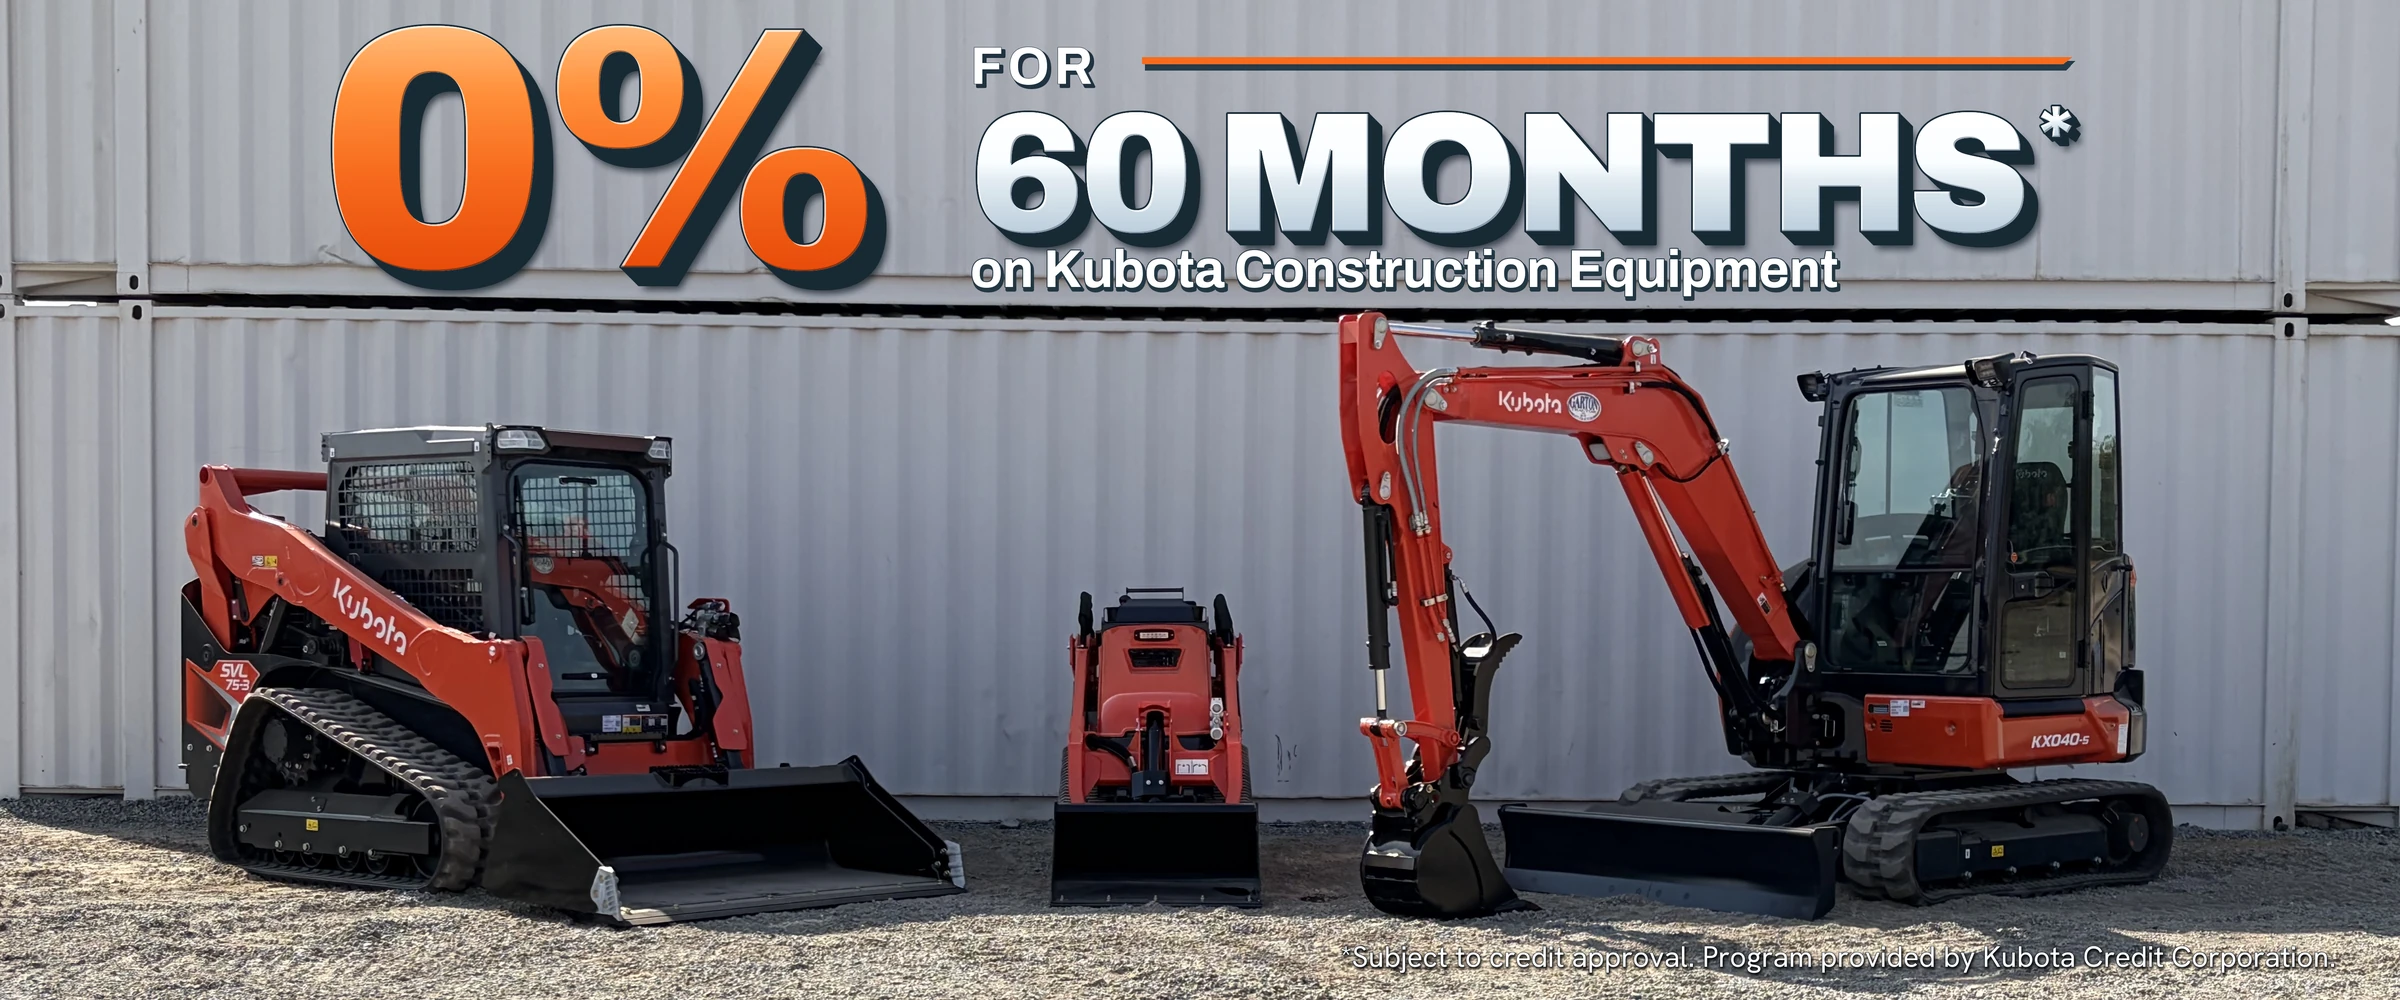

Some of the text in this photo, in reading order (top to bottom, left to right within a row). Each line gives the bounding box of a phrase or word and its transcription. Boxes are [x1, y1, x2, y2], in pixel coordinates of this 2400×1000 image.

[1498, 390, 1562, 414] Kubota
[332, 577, 407, 656] Kubota
[220, 663, 248, 678] SVL
[225, 679, 250, 691] 75-3
